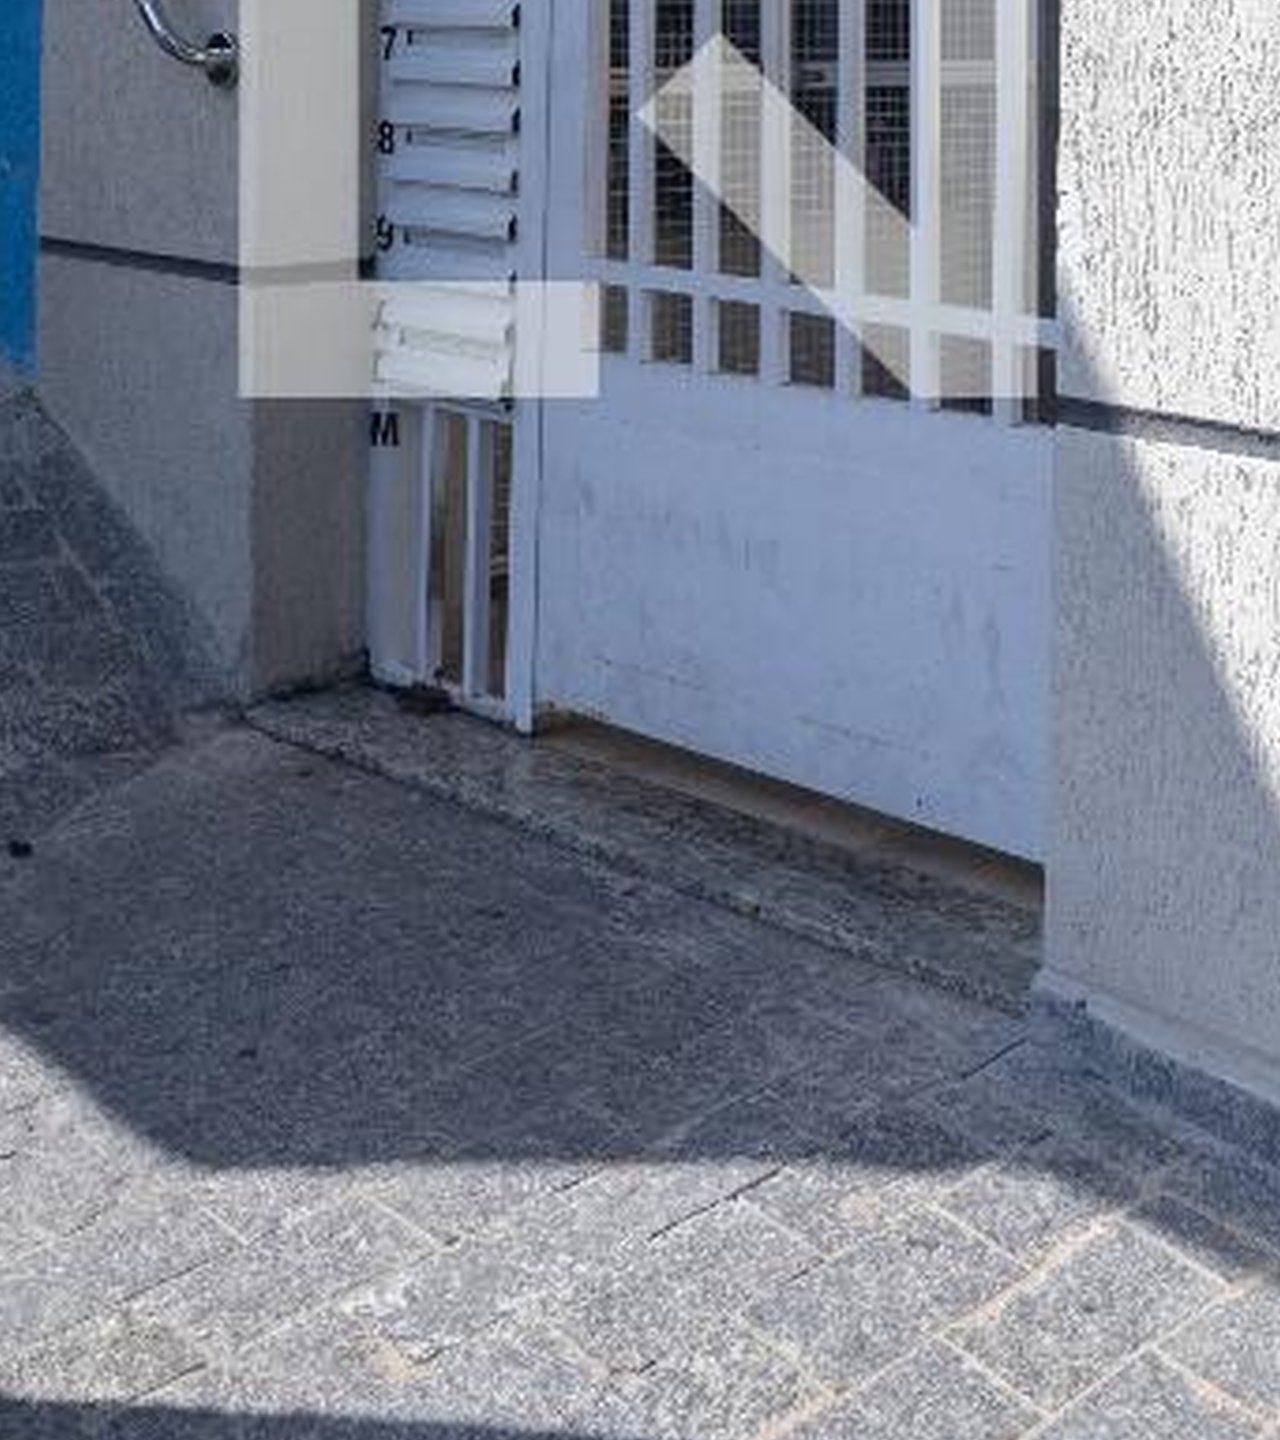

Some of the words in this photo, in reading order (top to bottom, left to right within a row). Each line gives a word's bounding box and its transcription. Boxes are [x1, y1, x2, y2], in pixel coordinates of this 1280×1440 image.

[380, 25, 397, 61] 7
[378, 120, 395, 155] 8
[376, 215, 394, 252] 9
